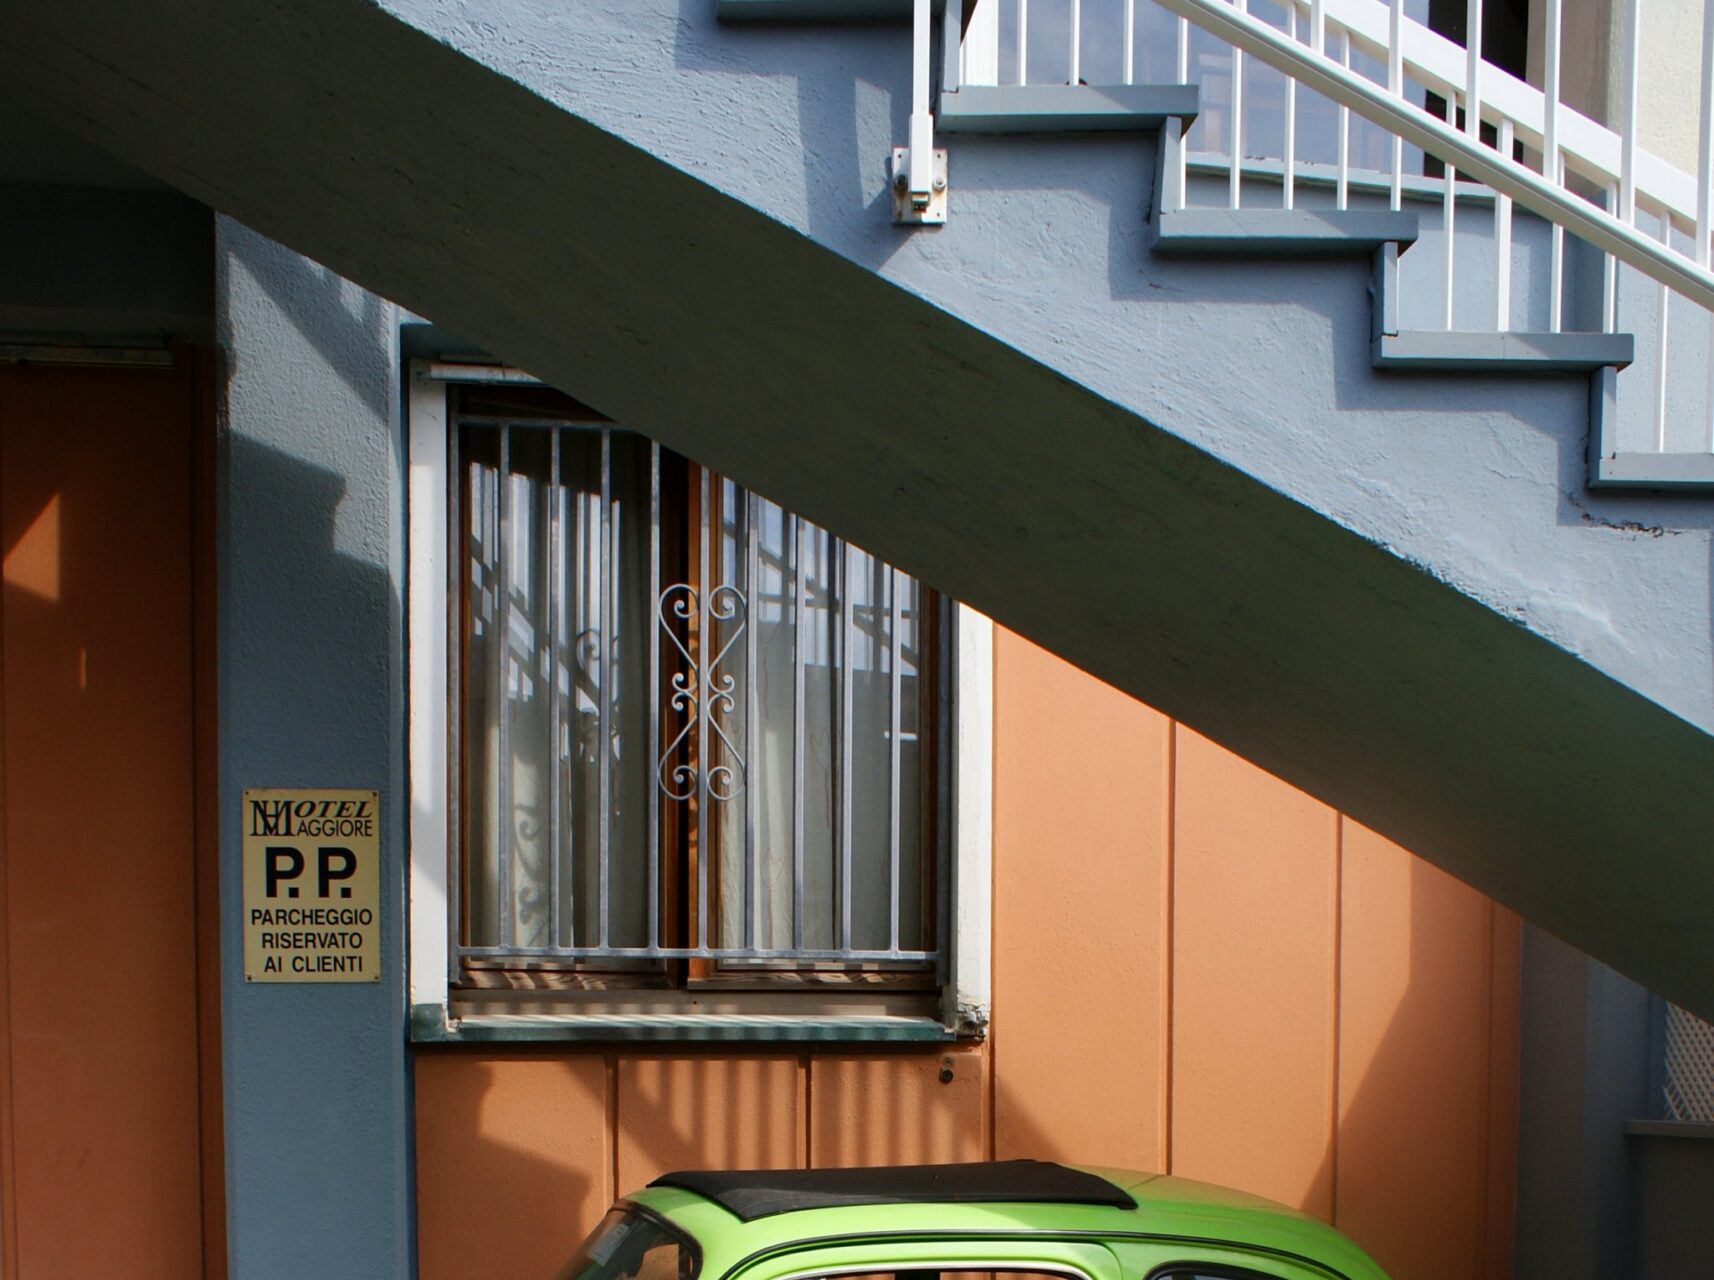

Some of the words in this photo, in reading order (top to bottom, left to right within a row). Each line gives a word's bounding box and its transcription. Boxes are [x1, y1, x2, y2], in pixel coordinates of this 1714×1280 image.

[249, 800, 373, 837] MAGGIORE
[251, 908, 372, 926] PARCHEGGIO
[262, 932, 363, 949] RISERVATO
[264, 956, 282, 972] AI
[292, 956, 362, 972] CLIENTI
